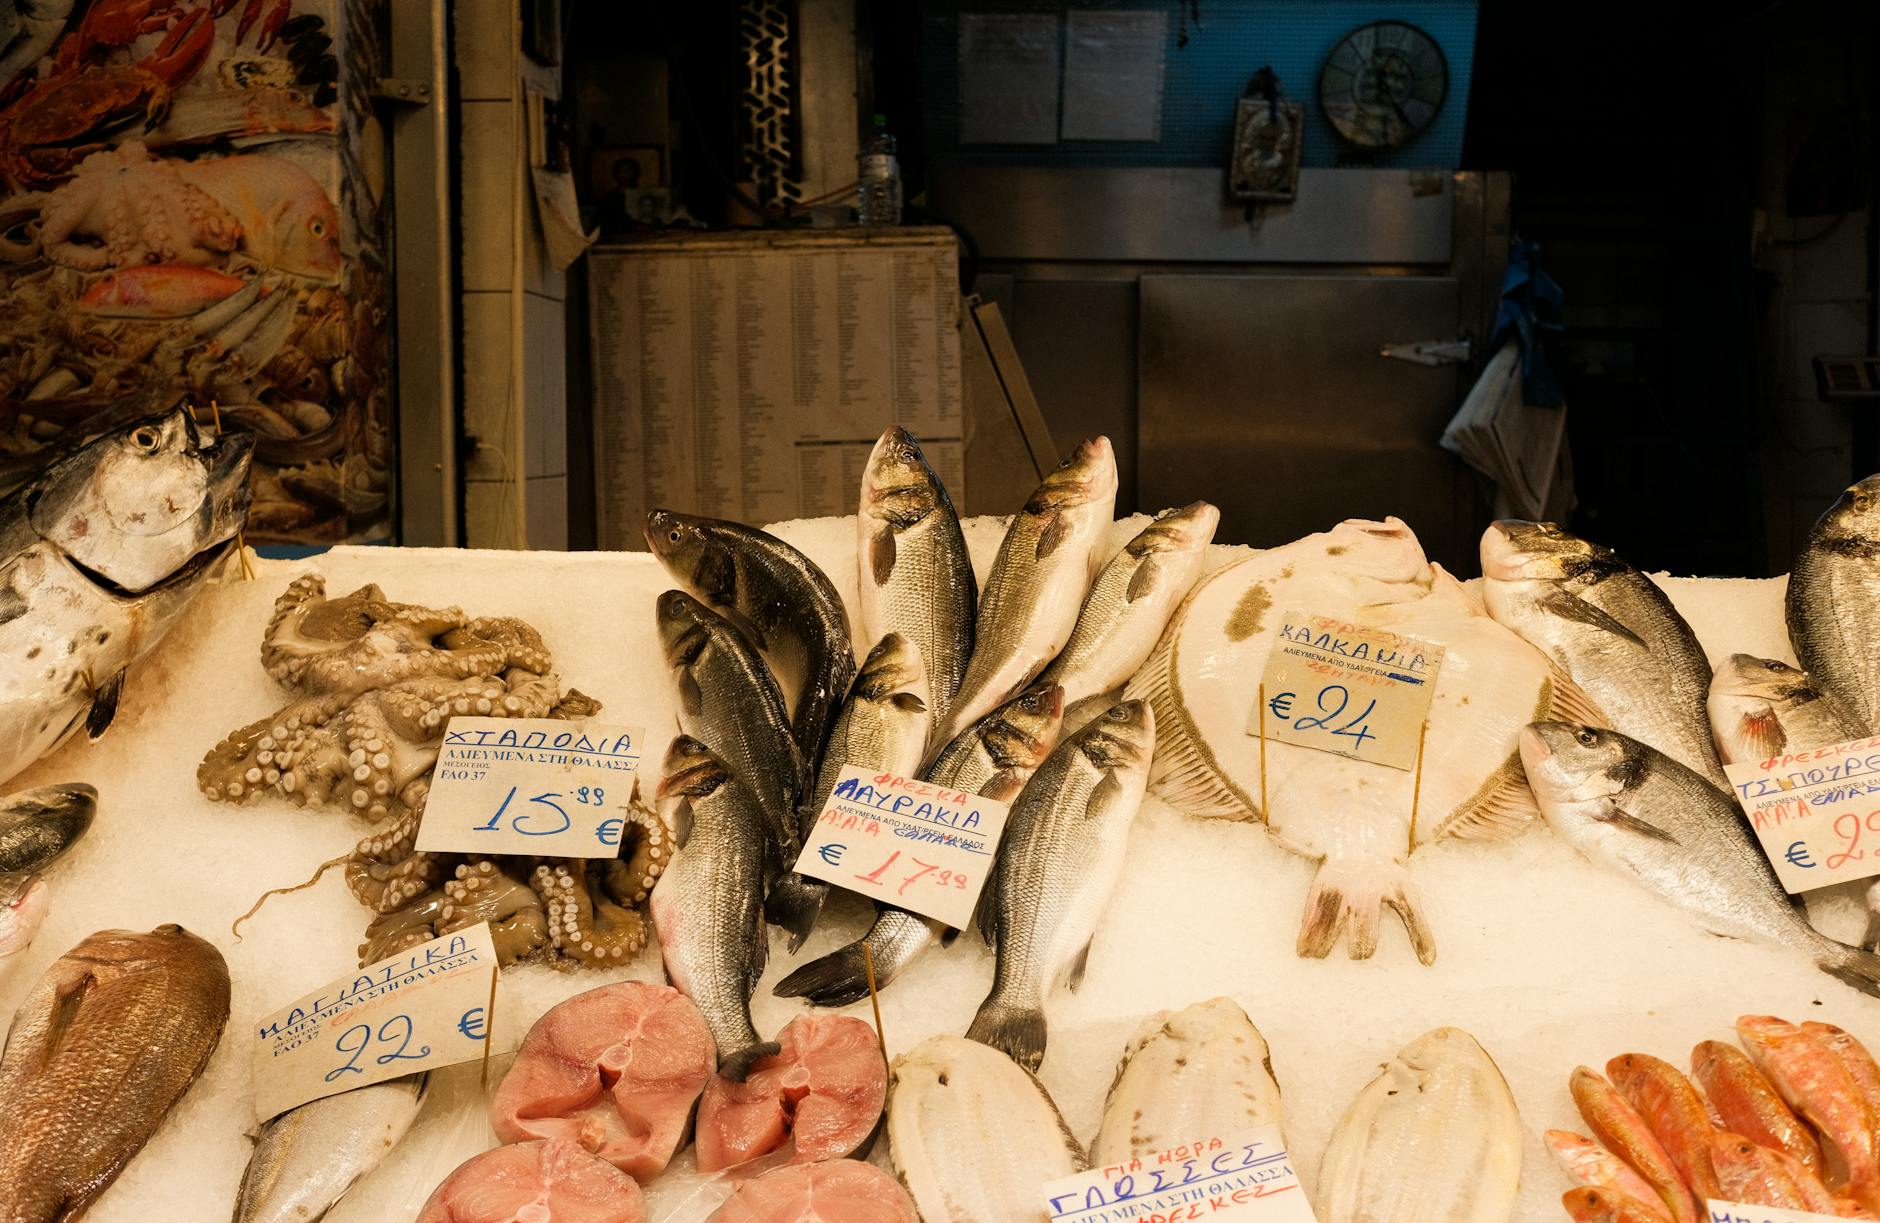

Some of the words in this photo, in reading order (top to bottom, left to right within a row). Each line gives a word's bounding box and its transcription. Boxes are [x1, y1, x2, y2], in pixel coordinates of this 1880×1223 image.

[1283, 646, 1326, 663] ΑΛΙΕΥΜΕΝΑ
[1327, 657, 1345, 667] ΑΠΟ
[1293, 685, 1377, 750] 24
[445, 729, 631, 754] ΧΤΑΠΟΔΙΑ
[447, 749, 534, 762] ΑΛΙΕΥΜΕΝΑ
[539, 753, 568, 765] ΣΤΗ
[471, 771, 486, 781] 37
[874, 772, 968, 806] ΦΡΕΣΚΑ
[1804, 790, 1820, 799] ΑΠΟ
[835, 804, 881, 823] ΑΛΙΕΥΜΕΝΑ
[882, 817, 901, 828] ΑΠΟ
[260, 936, 466, 1039] ΜΑΓΙΑΤΙΚΑ
[275, 996, 364, 1042] ΑΛΙΕΥΜΕΝΑ
[368, 981, 399, 999] ΣΤΗ
[404, 955, 478, 985] ΘΑΛΑΣΣΑ
[304, 1031, 319, 1043] 37
[325, 1015, 431, 1082] 22
[1049, 1142, 1272, 1214] ΓΛΩΣΣΕΣ
[1104, 1158, 1143, 1180] ΓΙΑ
[1168, 1187, 1205, 1207] ΣΤΗ
[1209, 1165, 1293, 1195] ΘΑΛΑΣΣΑ
